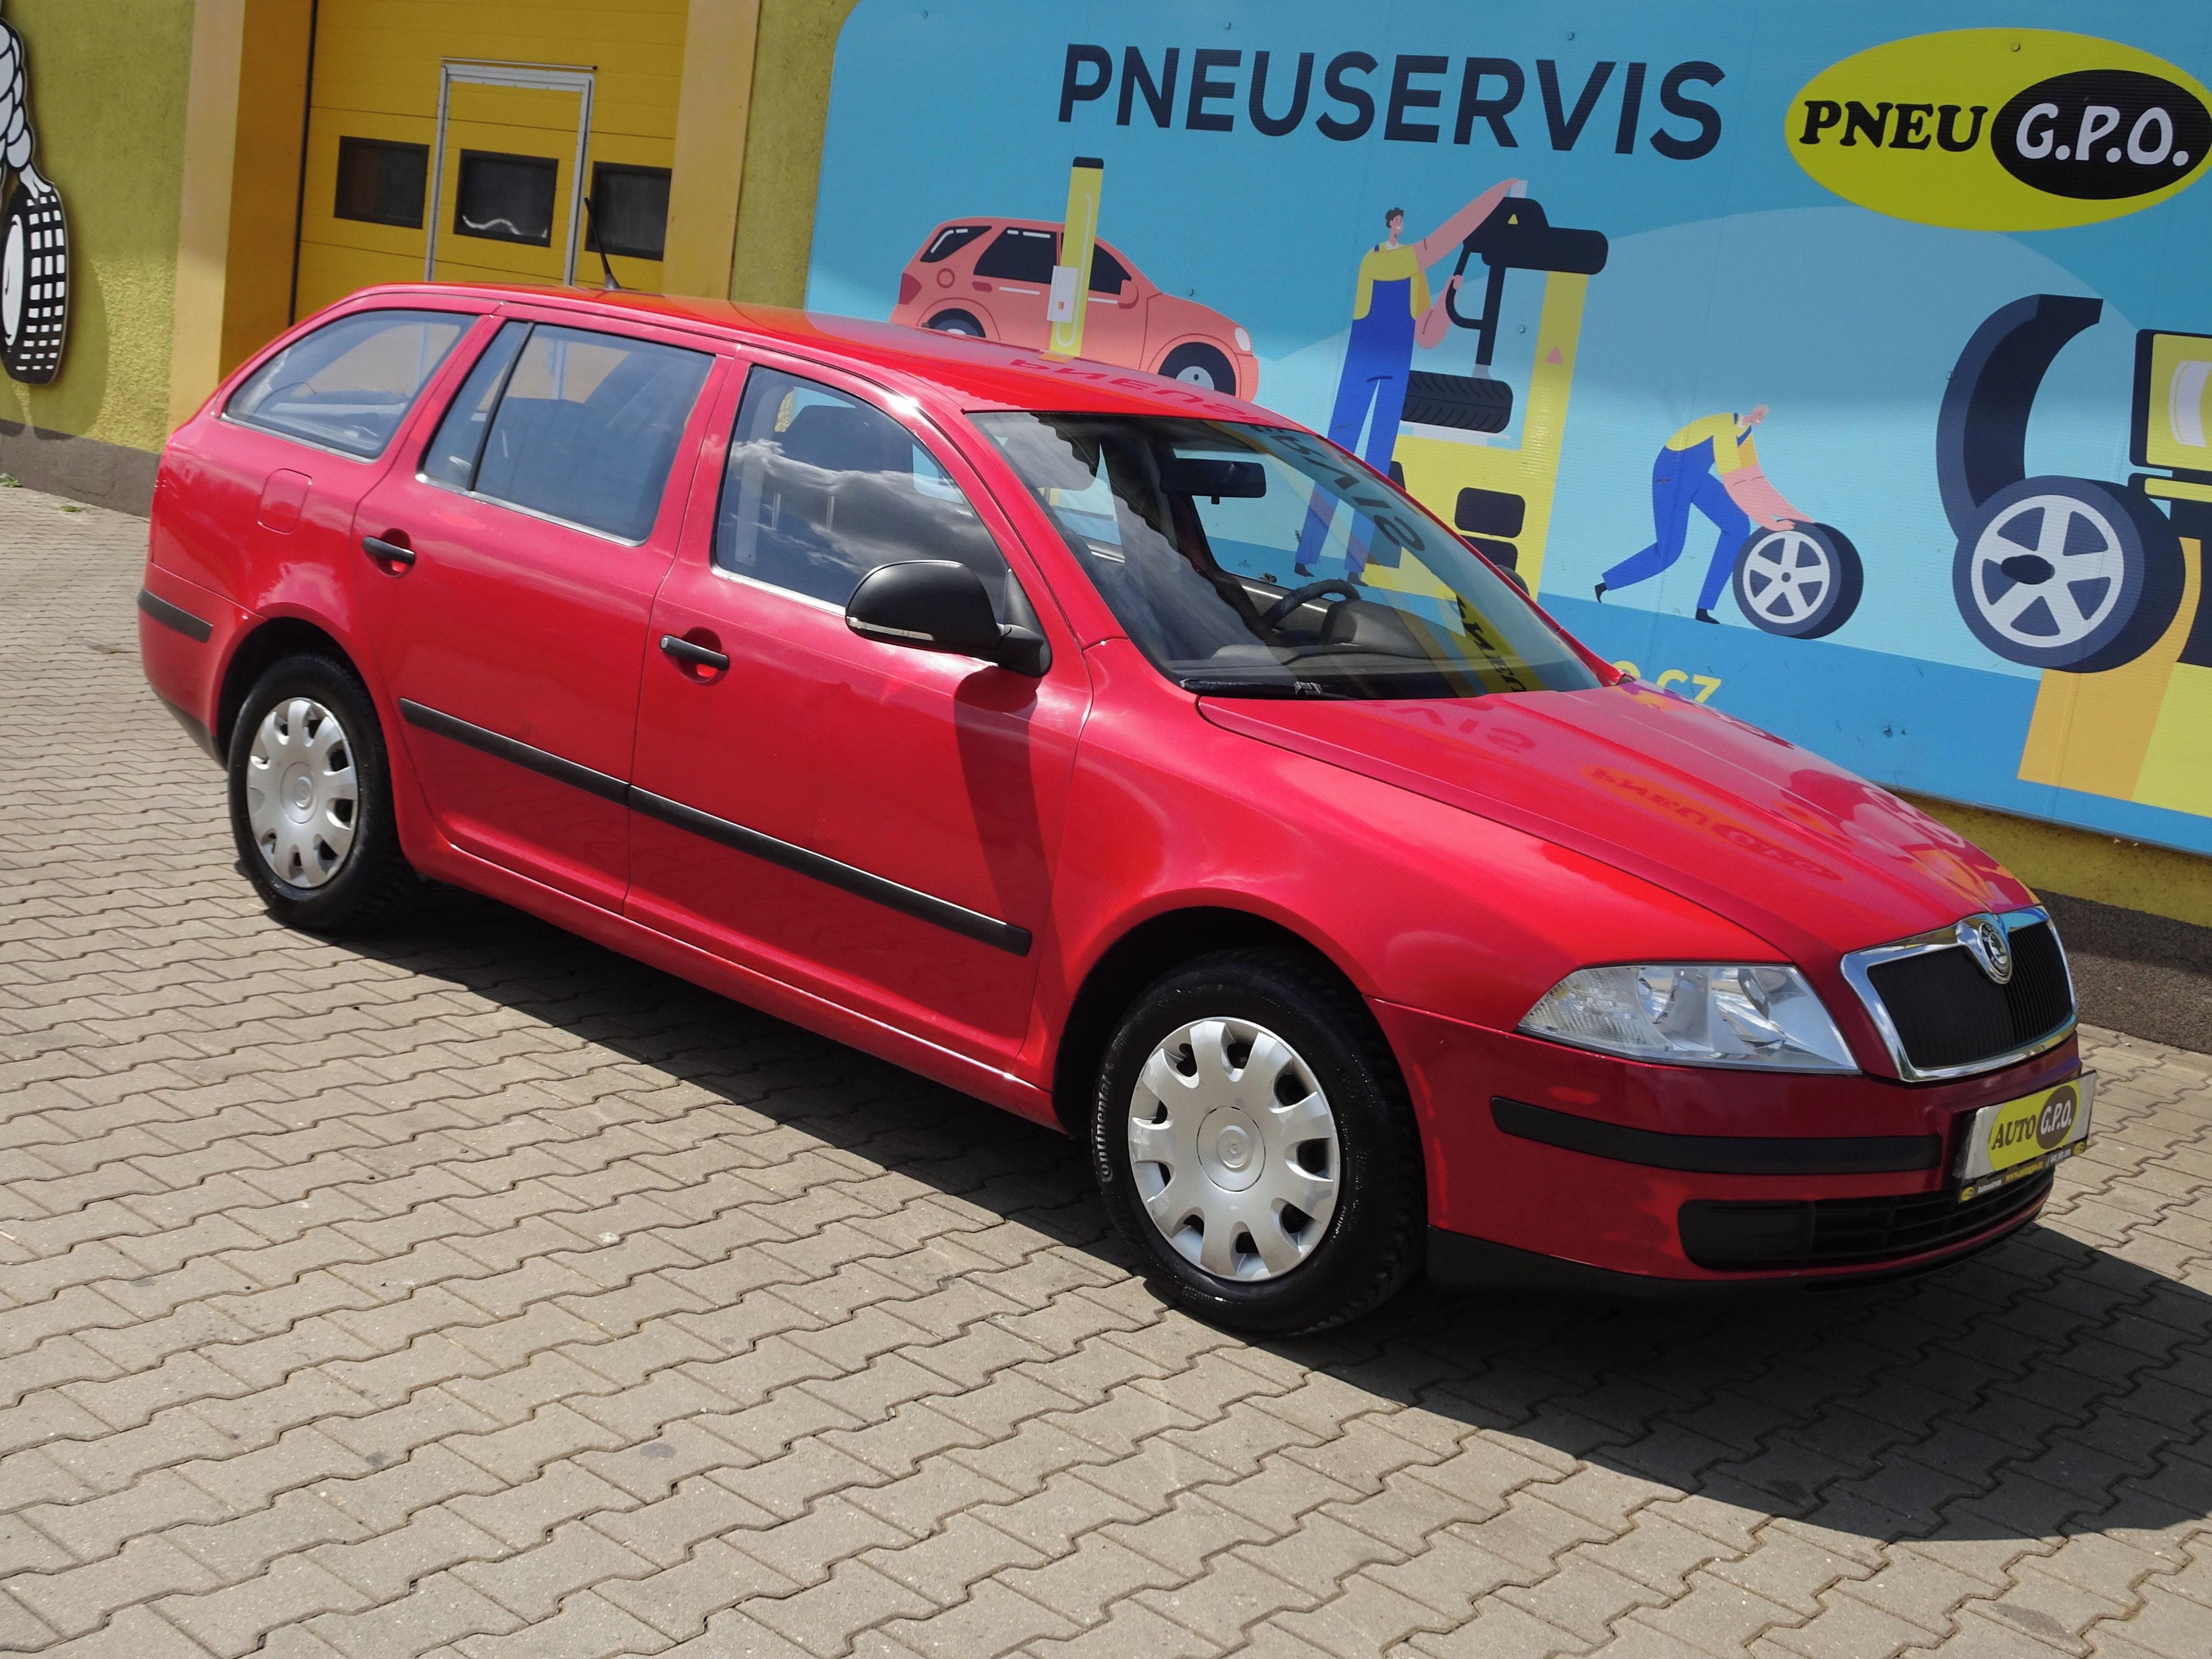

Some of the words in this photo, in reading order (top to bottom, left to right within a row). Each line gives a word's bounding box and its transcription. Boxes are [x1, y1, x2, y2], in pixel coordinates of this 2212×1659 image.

[1058, 43, 1726, 160] PNEUSERVIS
[1799, 100, 1988, 152] PNEU
[2015, 103, 2189, 167] G.P.O.
[1096, 1074, 1114, 1183] Continental
[1991, 1114, 2036, 1150] AUTO
